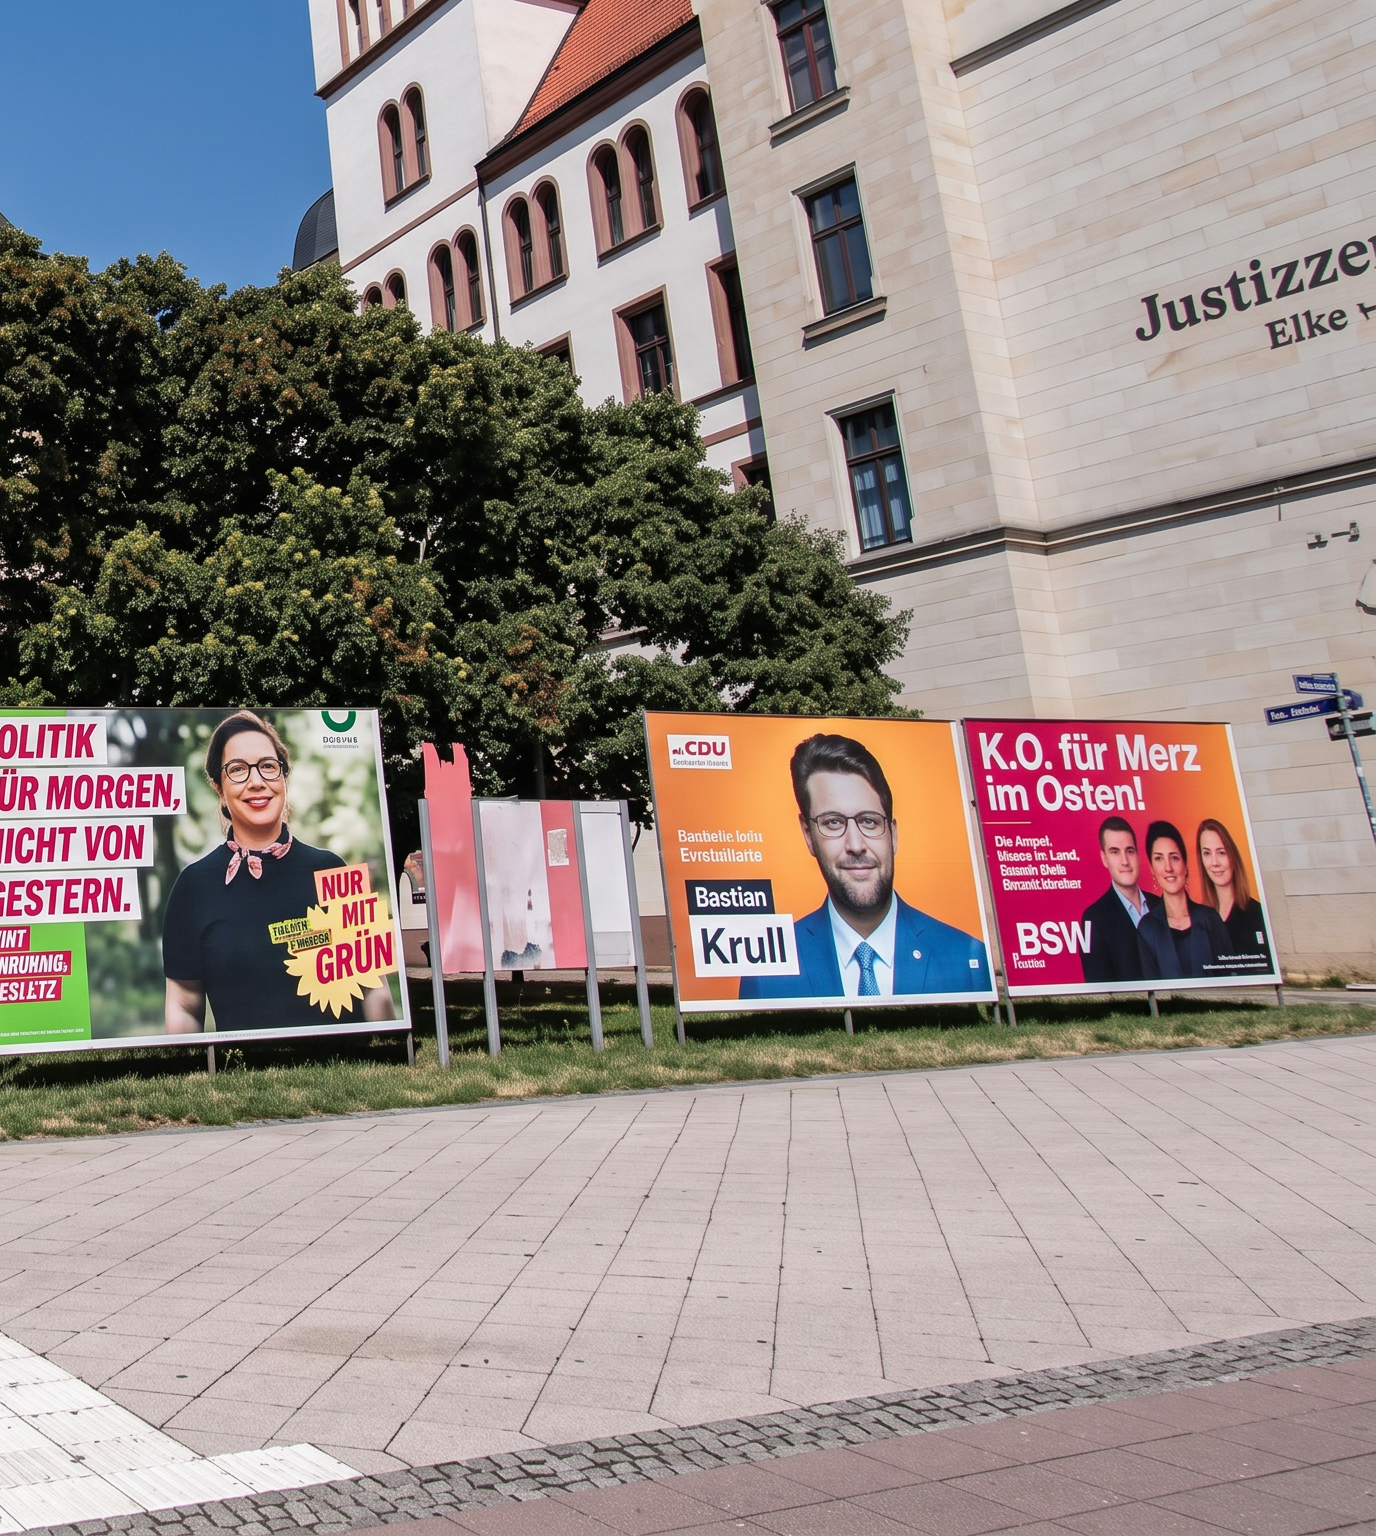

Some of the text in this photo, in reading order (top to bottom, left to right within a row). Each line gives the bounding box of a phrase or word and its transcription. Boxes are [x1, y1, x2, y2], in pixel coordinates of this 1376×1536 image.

[1134, 234, 1376, 342] Justizze
[1264, 307, 1350, 351] Elke
[684, 740, 726, 757] CDU
[978, 732, 1202, 772] K.O. für Merz
[46, 773, 181, 813] MORGEN,
[985, 774, 1147, 812] im Osten!
[84, 824, 146, 861] VON
[994, 835, 1013, 848] Die
[321, 869, 363, 902] NUR
[695, 886, 768, 908] Bastian
[342, 897, 378, 930] MIT
[315, 928, 393, 985] GRÜN
[700, 927, 788, 965] Krull
[1015, 920, 1092, 956] BSW
